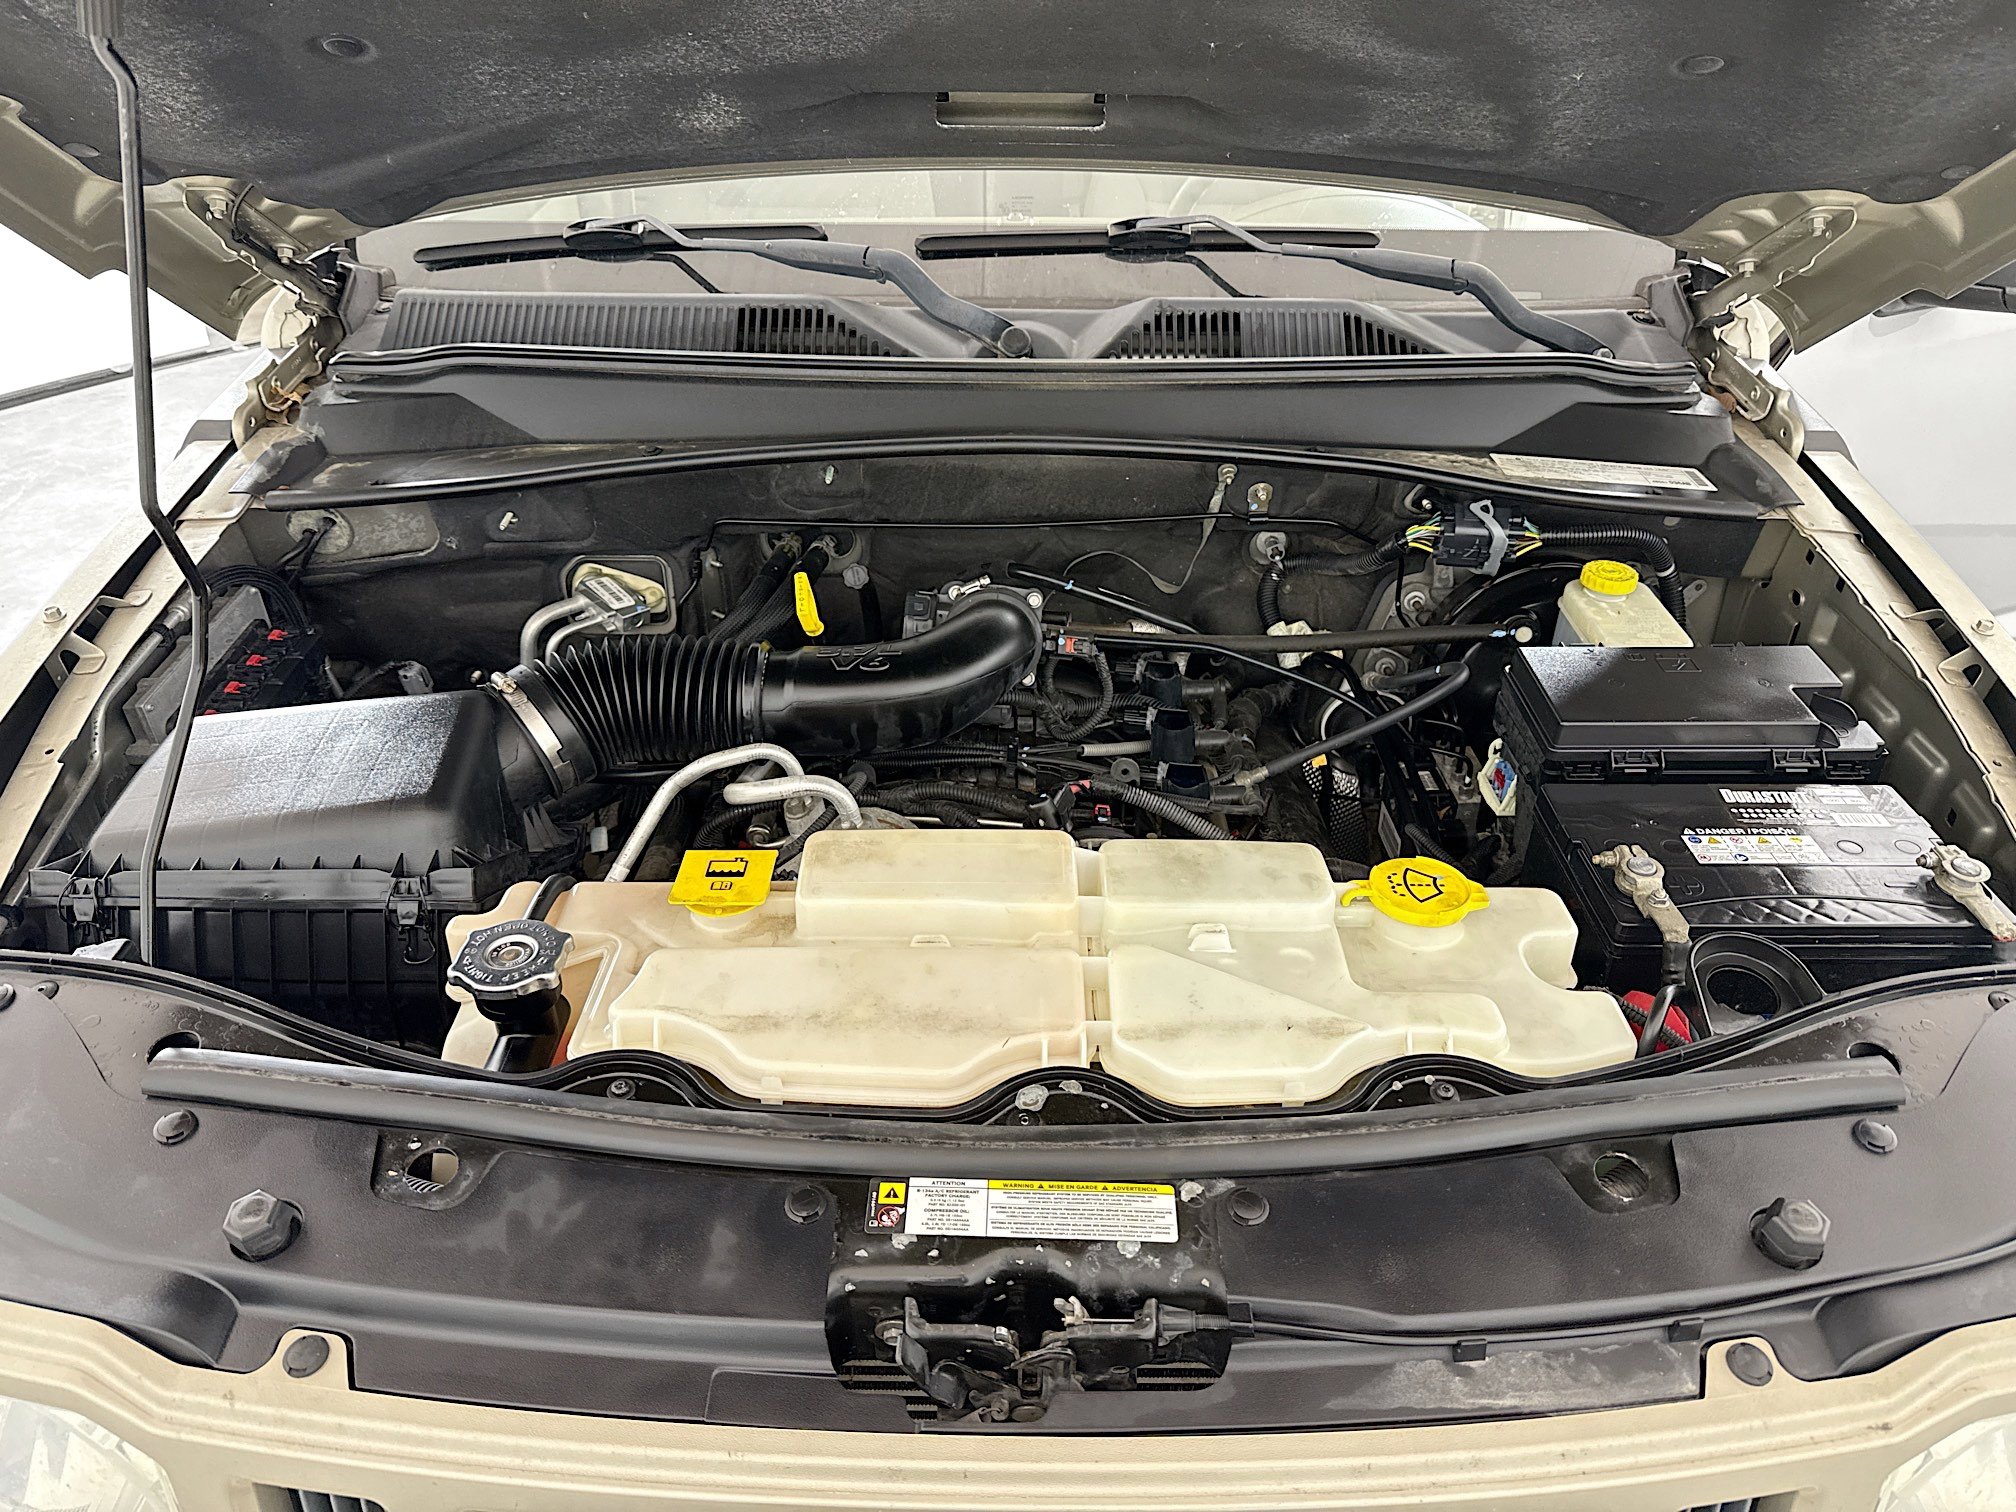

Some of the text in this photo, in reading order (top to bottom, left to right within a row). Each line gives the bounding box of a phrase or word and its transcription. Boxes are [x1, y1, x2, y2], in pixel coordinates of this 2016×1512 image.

[829, 656, 890, 672] V6
[1718, 788, 1810, 804] DURASTART
[1695, 827, 1746, 835] DANGER
[493, 922, 528, 934] OPEN
[529, 923, 549, 937] NOT
[471, 930, 491, 947] HOT
[464, 962, 537, 983] KEEP TIGHT
